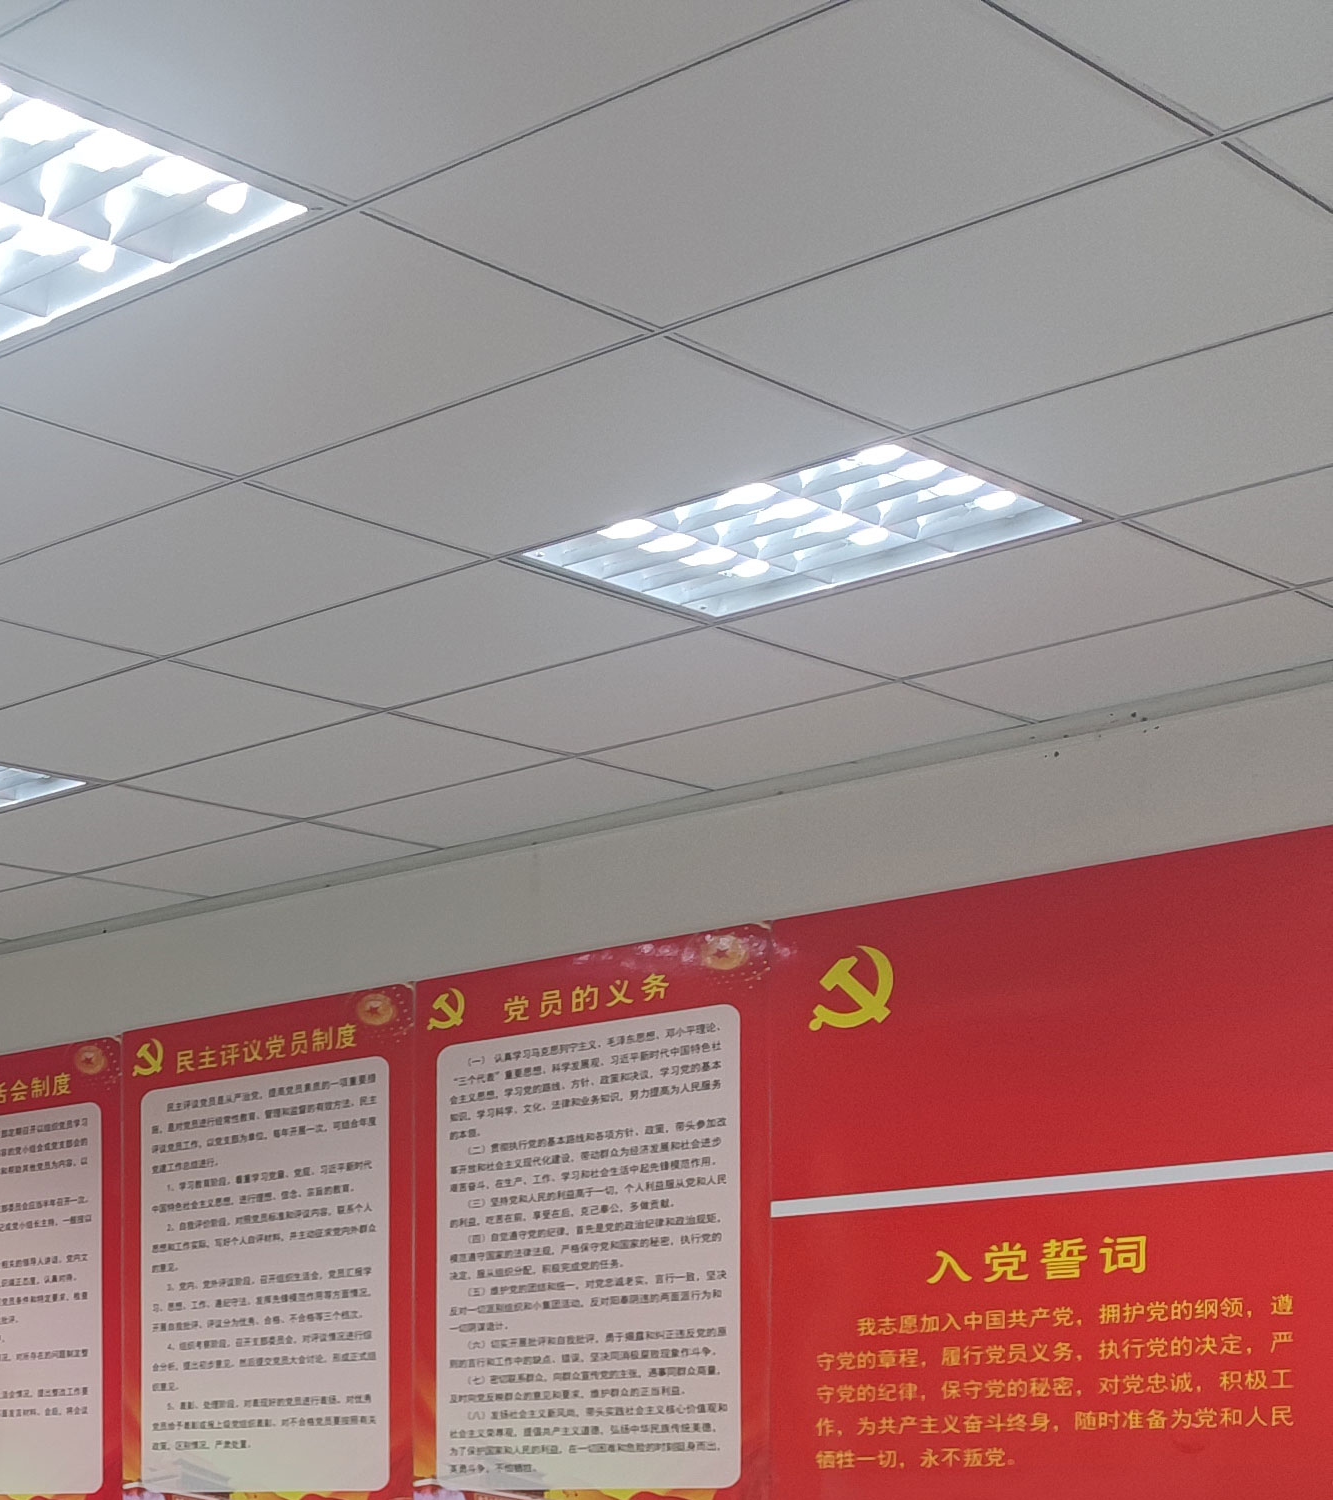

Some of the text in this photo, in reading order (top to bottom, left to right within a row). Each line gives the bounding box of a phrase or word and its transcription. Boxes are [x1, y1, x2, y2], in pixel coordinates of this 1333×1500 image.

[502, 973, 670, 1026] 党员的义务
[176, 1022, 358, 1073] 民主评议党员制度
[927, 1234, 1148, 1285] 入党誓词
[857, 1293, 1292, 1336] 我志愿加入中国共产党，拥护党的纲领，遵
[817, 1330, 1292, 1372] 守党的章程，履行党员义务，执行党的决定，严
[817, 1367, 1293, 1404] 守党的纪律，保守党的秘密，对党忠诚，积极工
[815, 1405, 1293, 1437] 作，为共产主义奋斗终身，随时准备为党和人民
[816, 1446, 1014, 1469] 牺牲一切，永不叛党。
